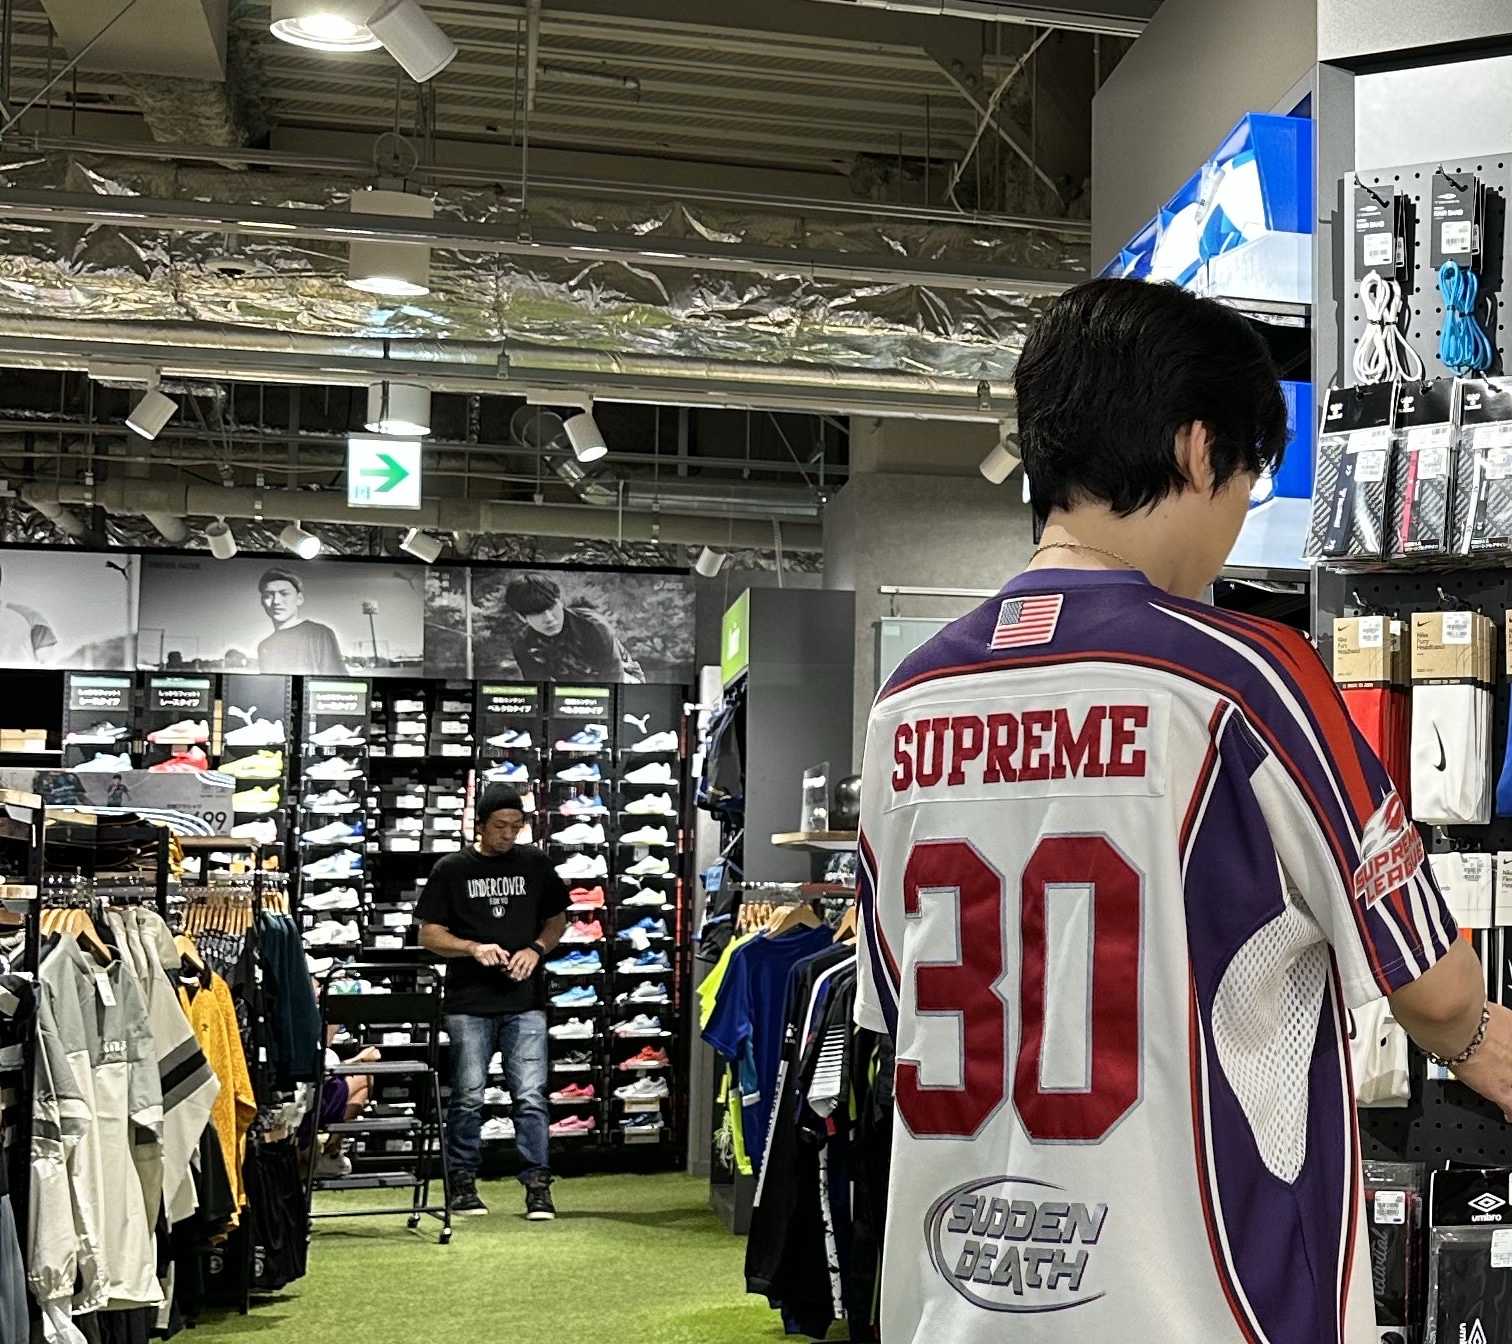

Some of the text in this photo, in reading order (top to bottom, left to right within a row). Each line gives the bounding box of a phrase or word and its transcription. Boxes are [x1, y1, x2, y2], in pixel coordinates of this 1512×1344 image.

[892, 704, 1150, 793] SUPREME
[467, 875, 527, 898] UNDERCOVER
[894, 833, 1147, 1145] 30
[947, 1194, 1109, 1245] SUDDEN
[1471, 1213, 1502, 1223] umbro
[953, 1239, 1089, 1296] DEATH
